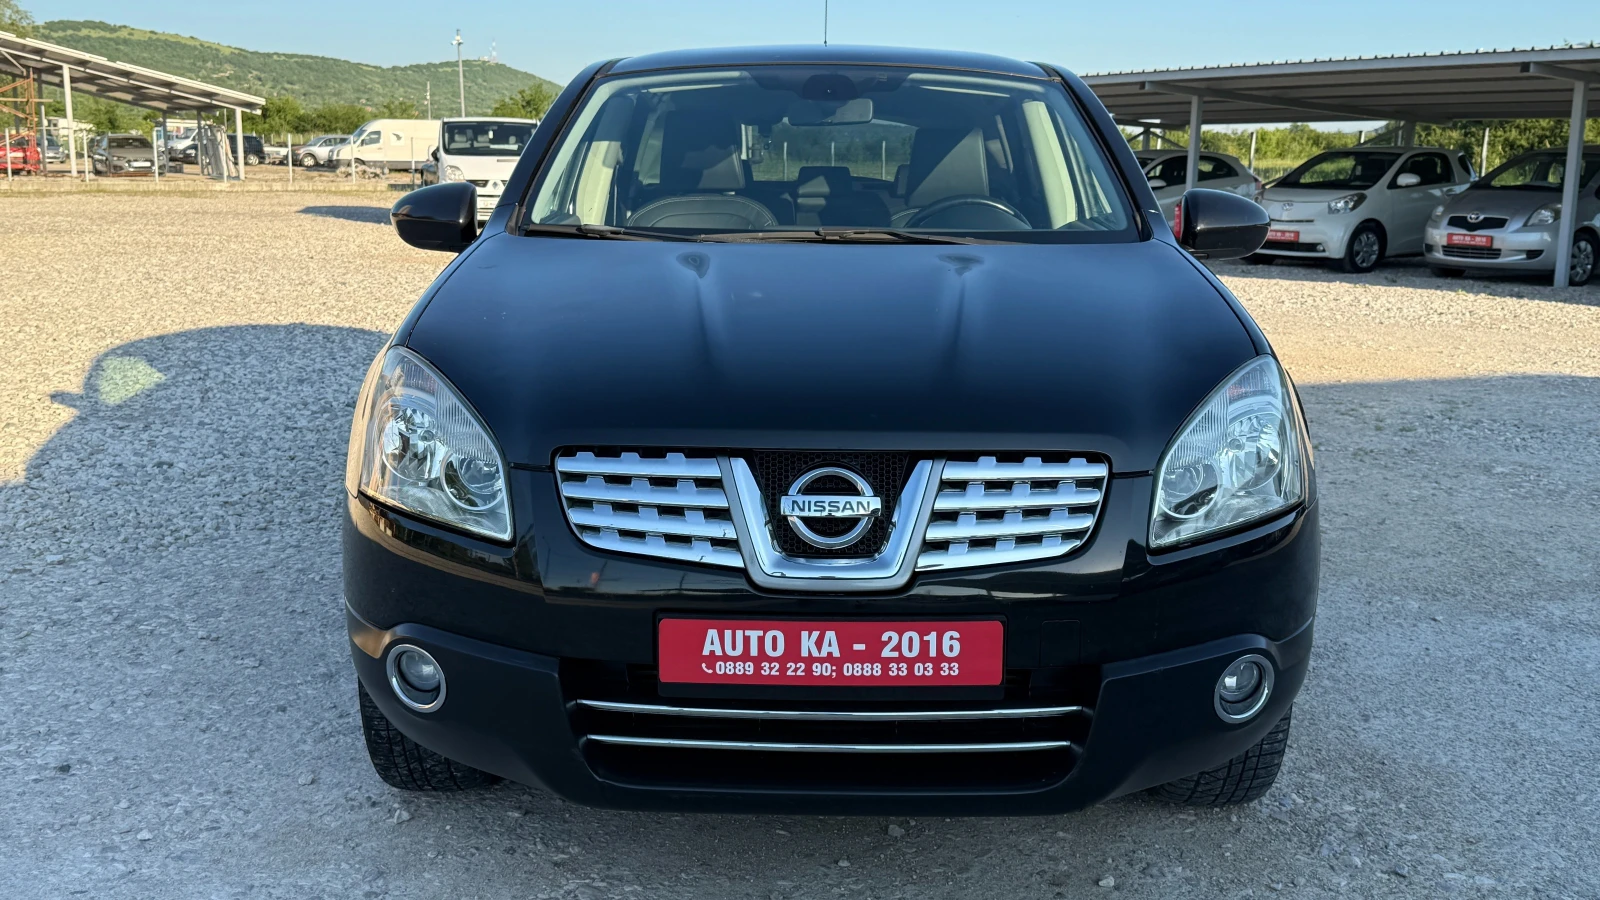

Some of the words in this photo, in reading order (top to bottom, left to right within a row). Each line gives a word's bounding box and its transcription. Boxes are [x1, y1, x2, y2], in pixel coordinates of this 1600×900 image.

[791, 500, 870, 513] NISSAN
[701, 629, 785, 657] AUTO
[800, 630, 841, 658] KA
[852, 643, 866, 651] -
[880, 631, 961, 658] 2016
[715, 661, 755, 675] 0889
[760, 662, 780, 676] 32
[786, 662, 806, 676] 22
[811, 663, 837, 679] 90;
[842, 663, 882, 677] 0888
[888, 663, 908, 677] 33
[914, 663, 934, 677] 03
[939, 662, 960, 676] 33
